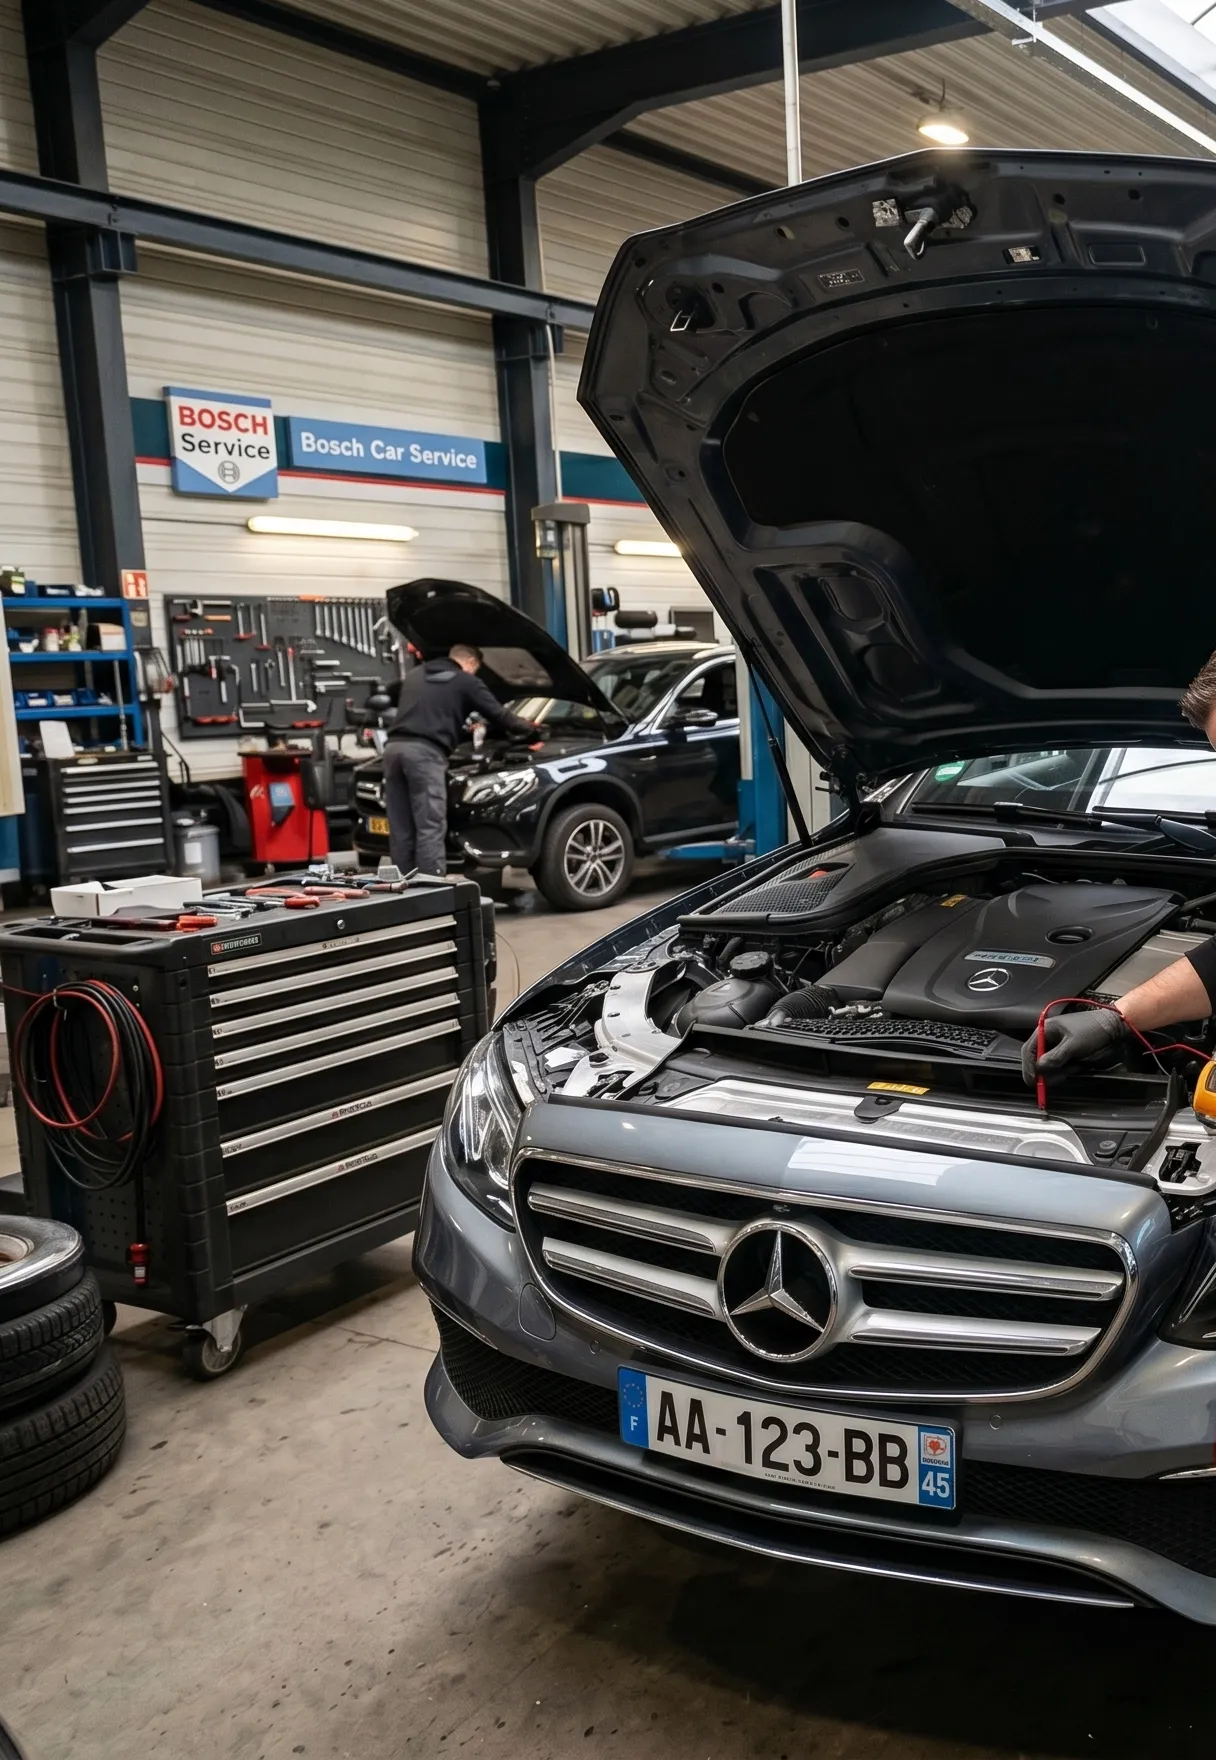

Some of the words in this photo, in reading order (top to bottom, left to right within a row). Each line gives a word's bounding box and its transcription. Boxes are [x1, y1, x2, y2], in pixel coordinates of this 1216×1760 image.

[178, 405, 269, 436] BOSCH
[181, 432, 270, 460] Service
[300, 431, 364, 457] Bosch
[370, 440, 404, 461] Car
[410, 443, 477, 469] Service
[630, 1415, 639, 1432] F
[655, 1390, 910, 1491] AA-123-BB
[921, 1470, 950, 1498] 45
